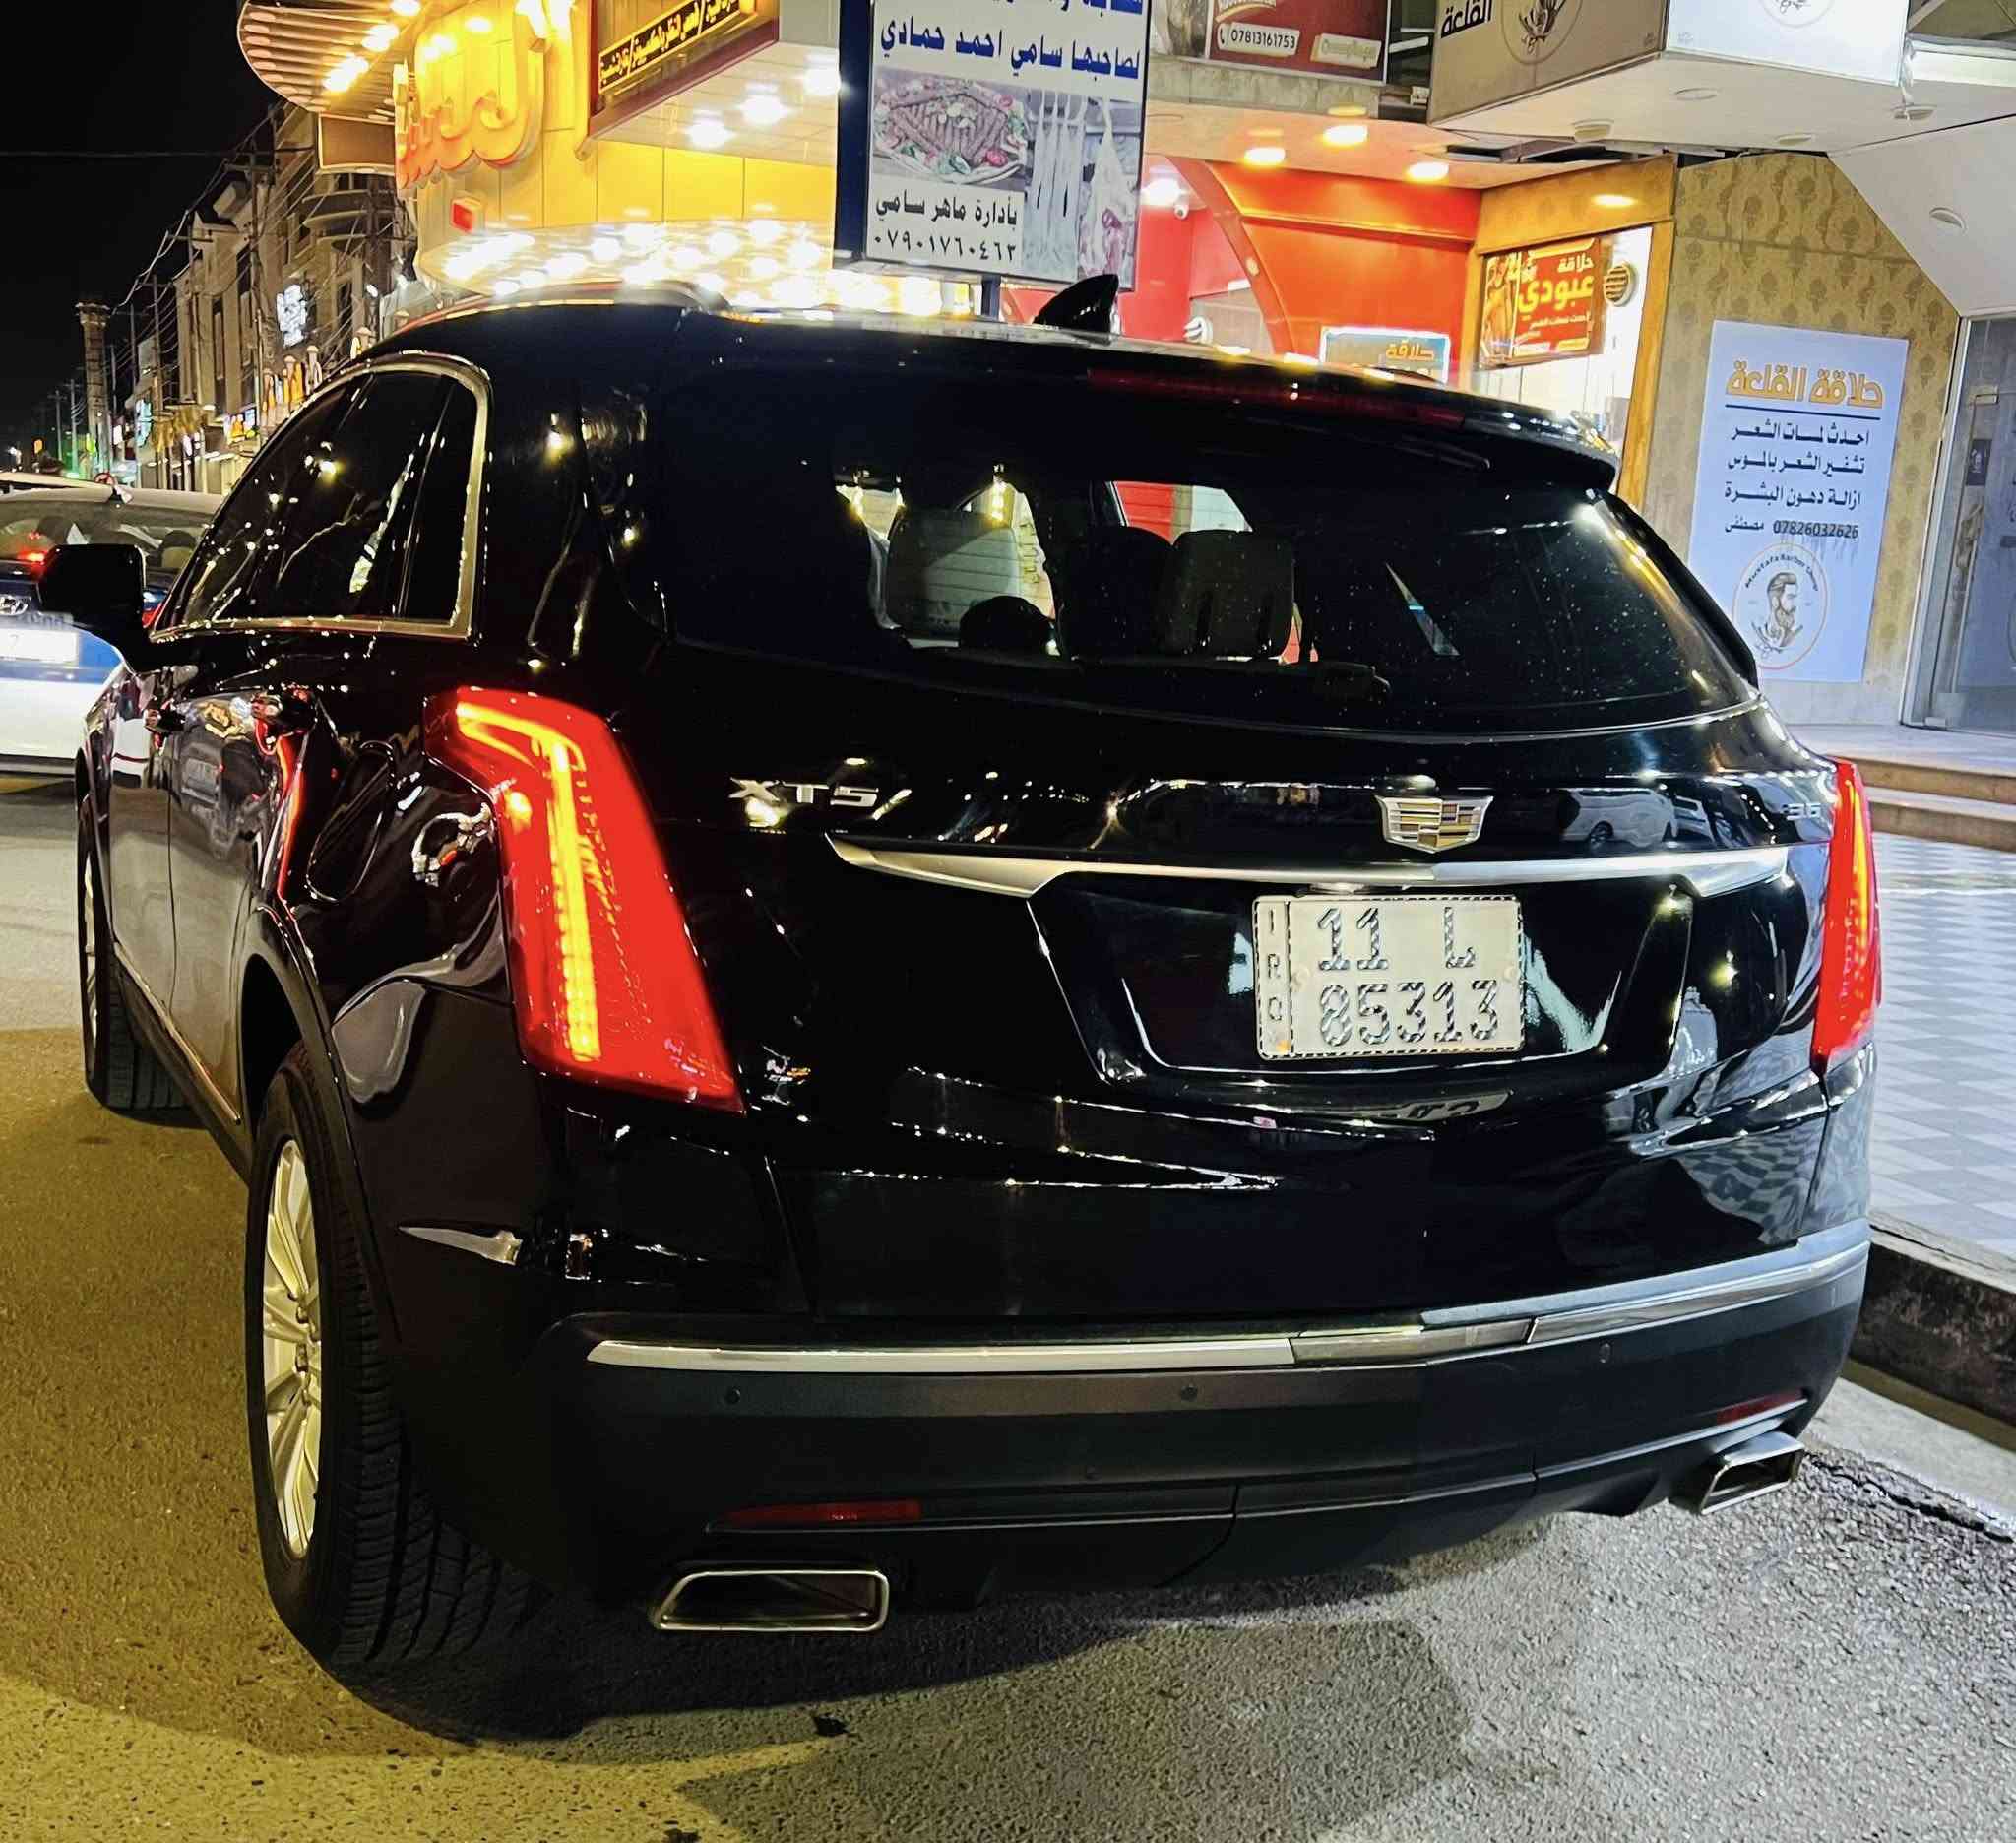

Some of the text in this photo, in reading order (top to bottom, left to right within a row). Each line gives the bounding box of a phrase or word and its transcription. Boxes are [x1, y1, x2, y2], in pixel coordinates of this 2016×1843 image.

[881, 16, 1140, 82] لصاحبها سامي احمد حمادي
[1231, 29, 1295, 49] 07813161753
[876, 189, 925, 222] سامي
[931, 196, 966, 222] ماهر
[1556, 252, 1594, 273] حلاقة
[1517, 276, 1595, 321] عبودي
[1385, 338, 1435, 362] حلاقة
[1726, 359, 1883, 410] حلاقة القلعة
[1731, 418, 1781, 440] الشعر
[1827, 422, 1869, 446] احدث
[1779, 451, 1820, 473] الشعر
[1725, 481, 1861, 511] ازالة دهون البشرة
[728, 777, 879, 807] XT5
[1317, 907, 1389, 971] 11
[1319, 979, 1498, 1047] 85313
